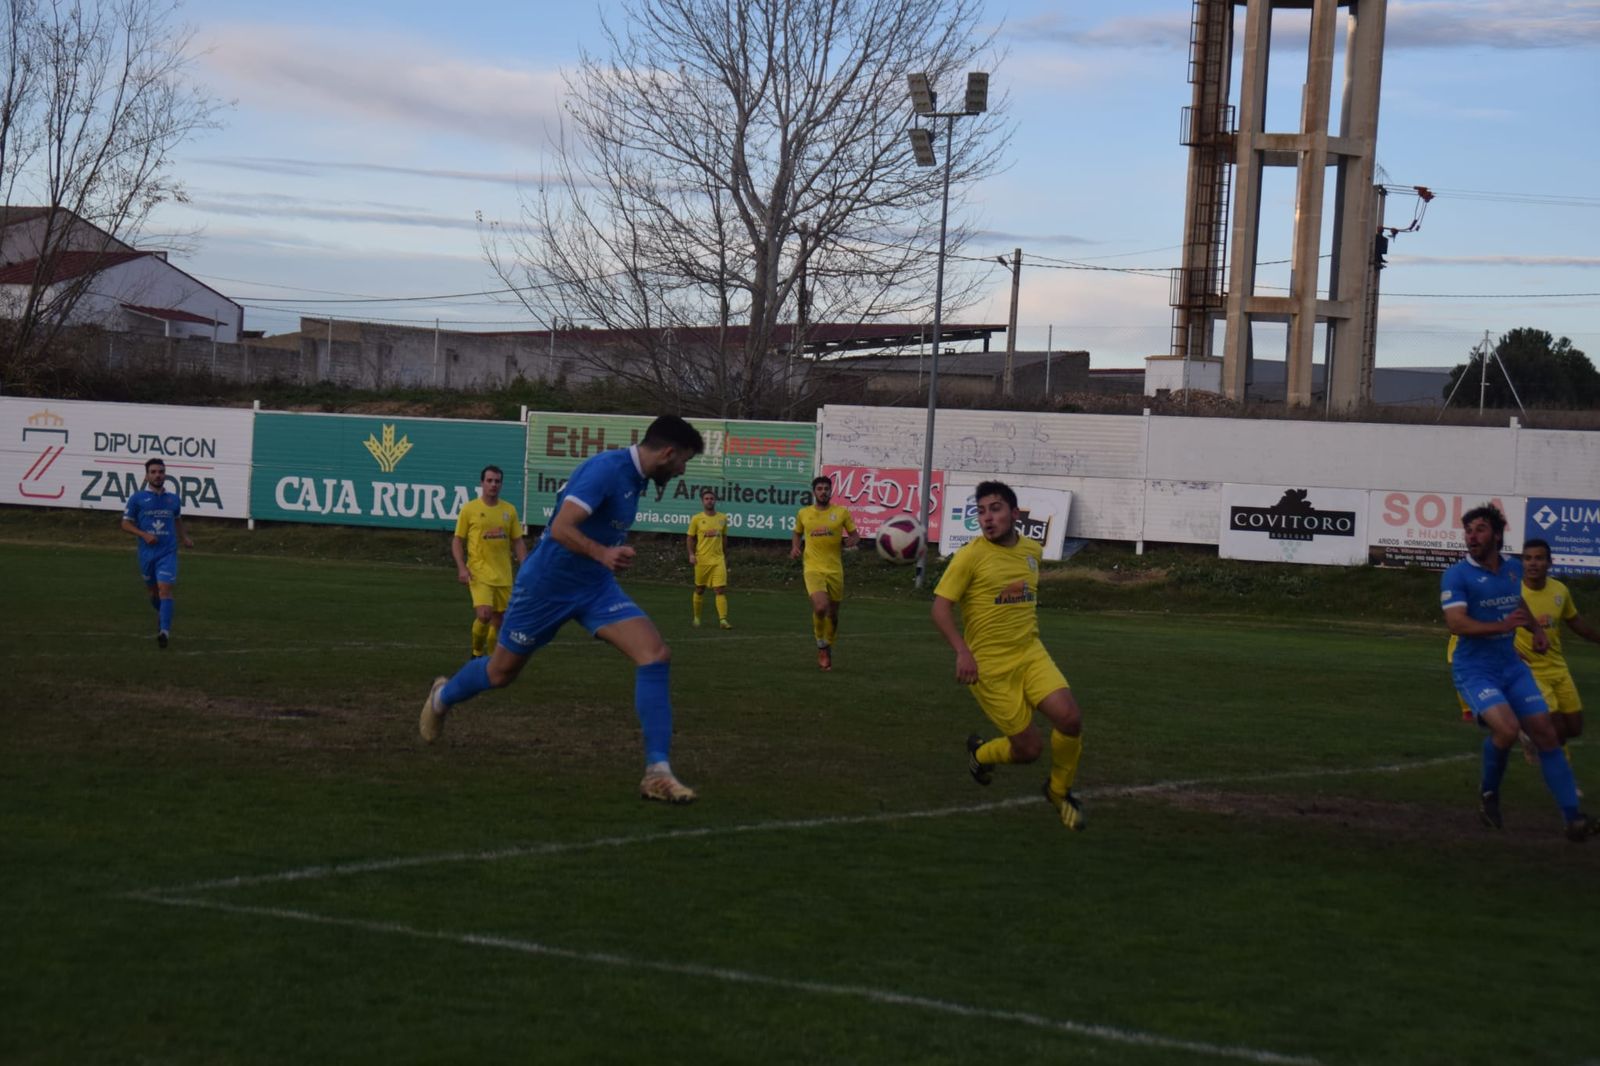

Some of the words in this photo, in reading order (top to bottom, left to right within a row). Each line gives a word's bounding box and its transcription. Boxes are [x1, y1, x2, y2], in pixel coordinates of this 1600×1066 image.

[275, 476, 362, 515] CAJA
[370, 481, 484, 520] RURA
[747, 514, 774, 529] 524
[1234, 512, 1351, 532] COVITORO
